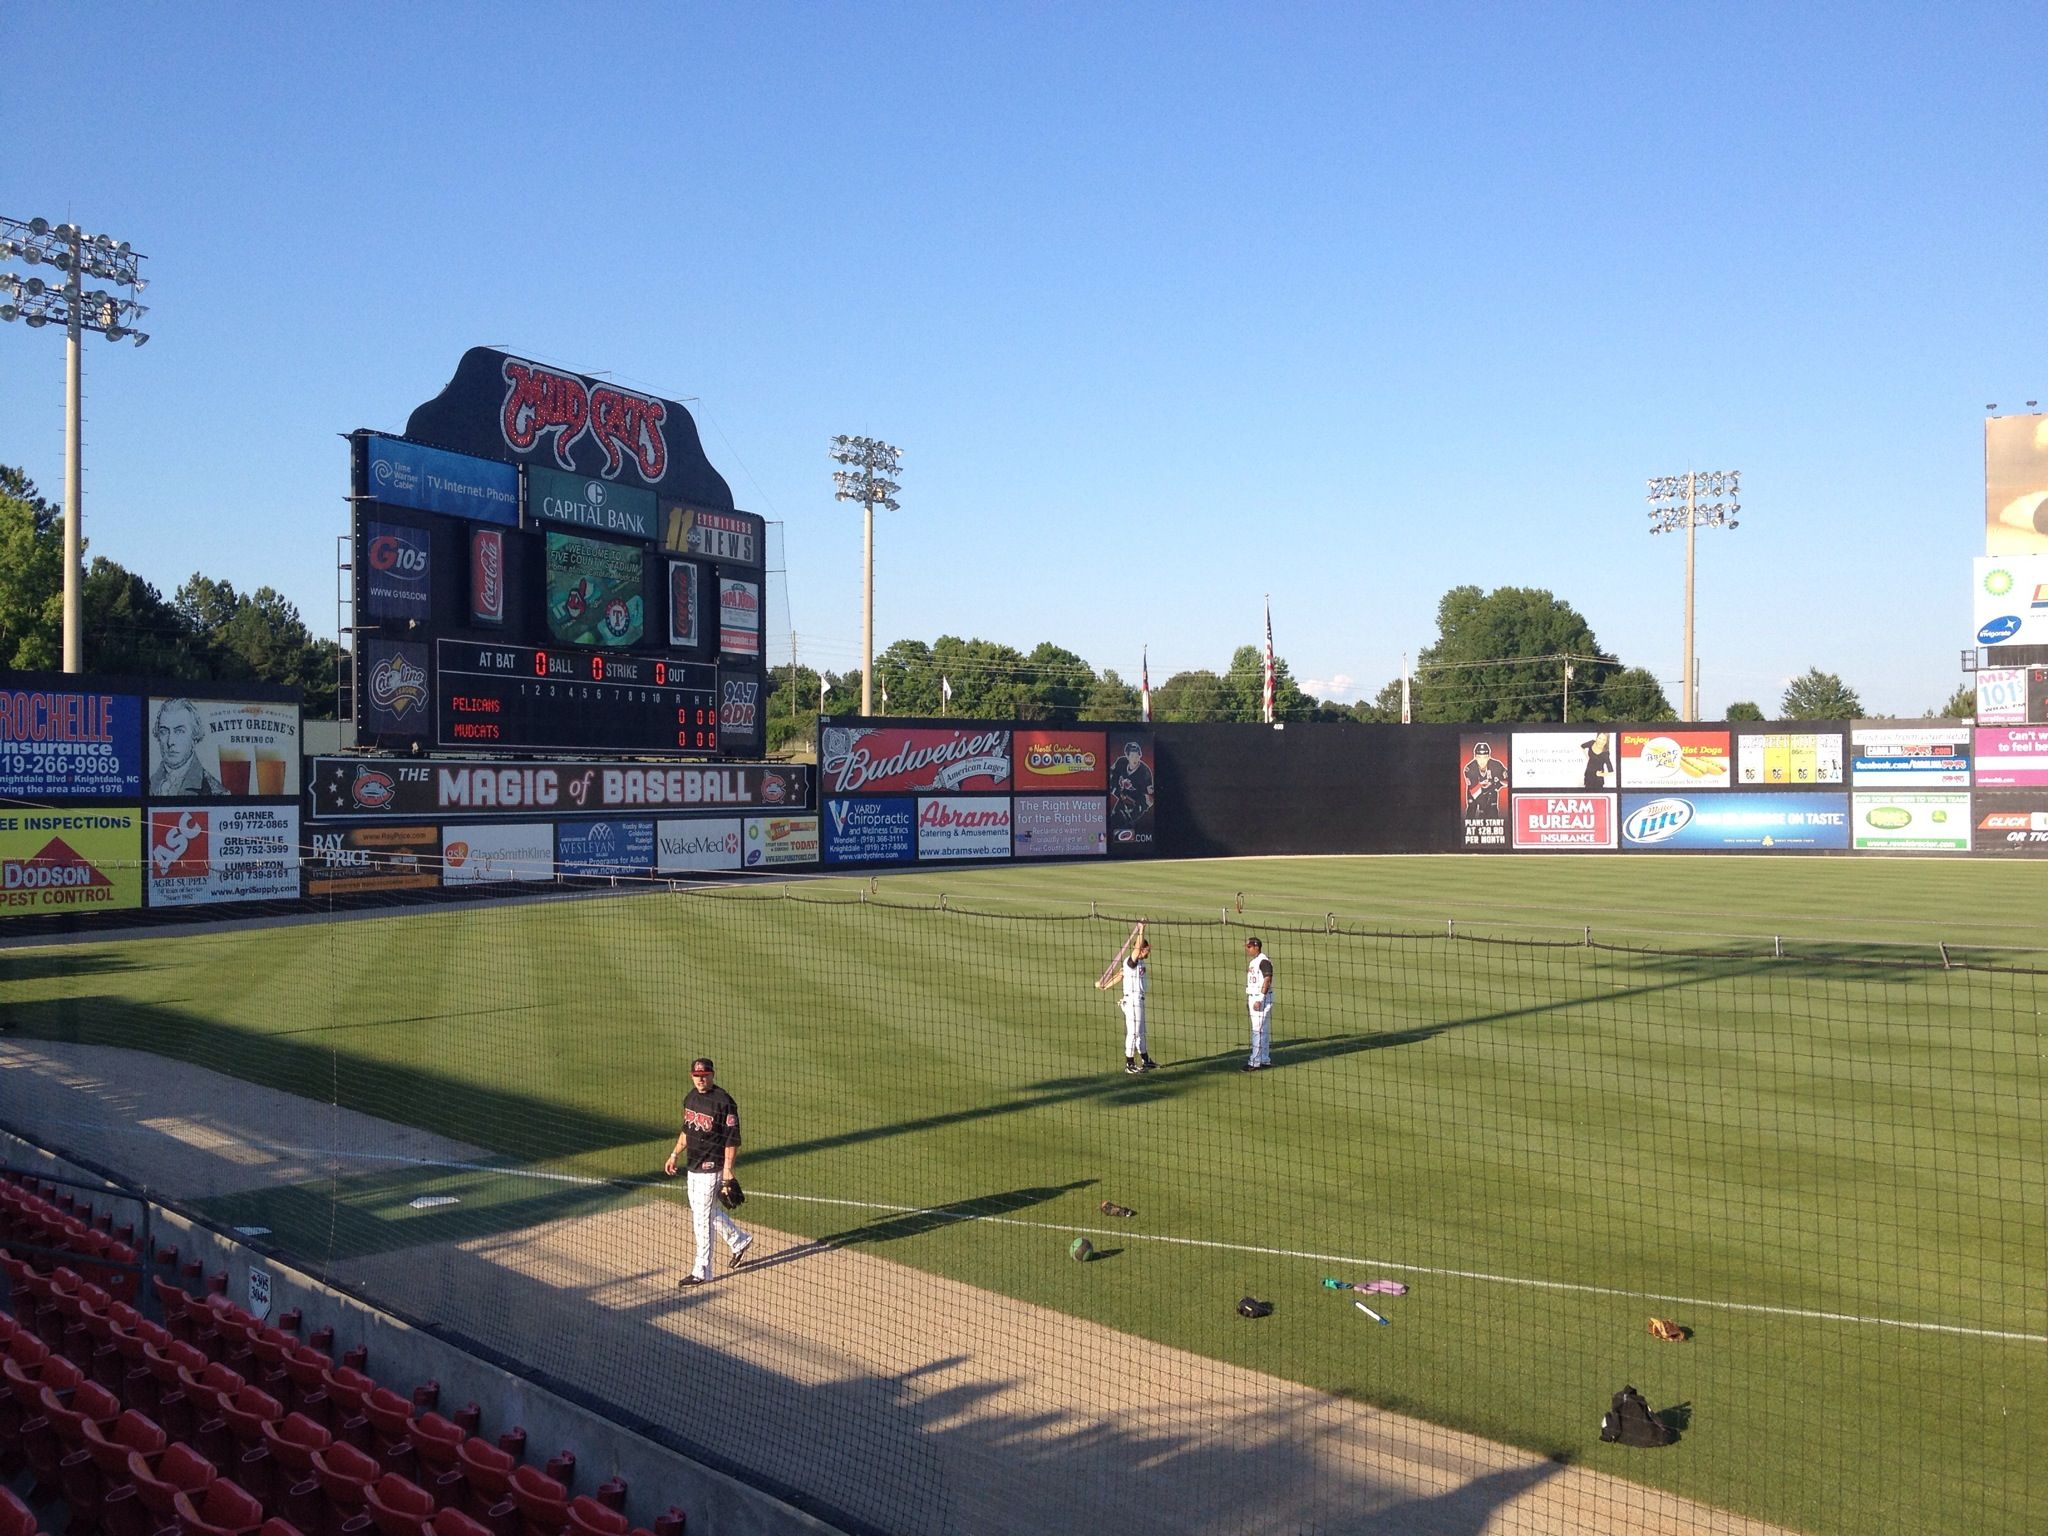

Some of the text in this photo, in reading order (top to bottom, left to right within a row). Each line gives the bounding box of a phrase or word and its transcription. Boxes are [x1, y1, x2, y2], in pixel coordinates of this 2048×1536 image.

[394, 462, 411, 473] Time
[394, 470, 419, 484] Warner
[394, 481, 414, 491] Cable
[543, 497, 645, 534] CAPITAL BANK
[697, 513, 752, 536] EYEWITNESS
[568, 544, 609, 560] WELCOME
[704, 533, 751, 562] NEWS
[551, 550, 569, 562] FIVE
[605, 562, 641, 577] STADIUM
[480, 652, 515, 669] AT BAT
[536, 652, 546, 676] 0
[549, 658, 573, 673] BALL
[593, 657, 603, 680] 0
[606, 663, 638, 679] STRIKE
[656, 663, 665, 685] 0
[669, 669, 686, 682] OUT
[1978, 671, 2018, 684] MIX
[521, 684, 525, 695] 1
[536, 685, 541, 696] 2
[550, 685, 555, 697] 3
[568, 686, 574, 697] 4
[583, 687, 587, 698] 5
[596, 688, 601, 699] 6
[615, 689, 619, 700] 7
[628, 690, 633, 701] 8
[641, 691, 646, 702] 9
[652, 692, 660, 703] 10
[724, 681, 758, 704] 94.7
[0, 692, 112, 743] ROCHELLE
[453, 697, 715, 726] PELICANS 0 0 0
[210, 719, 296, 736] NATTY GREENE'S
[231, 735, 263, 743] BREWING
[454, 723, 715, 748] MUDCATS 0 0 0
[1624, 737, 1650, 746] Enjoy
[2008, 731, 2036, 741] Can't
[1682, 746, 1723, 756] Hot Dogs
[1998, 742, 2032, 752] to feel
[824, 730, 1001, 792] Budweiser
[1032, 754, 1084, 766] POWER
[947, 761, 1005, 782] American Lager
[47, 775, 66, 784] Blvd
[27, 785, 43, 793] the
[72, 785, 96, 793] since
[398, 768, 752, 806] THE MAGIC of BASEBALL
[854, 804, 881, 814] VARDY
[1020, 800, 1101, 813] The Right Water
[1547, 799, 1595, 814] FARM
[234, 811, 274, 820] GARNER
[847, 812, 910, 827] Chiropractic
[918, 801, 1009, 828] Abrams
[1018, 812, 1104, 825] for the Right Use
[25, 816, 131, 830] INSPECTIONS
[220, 820, 288, 831] (919) 772-0865
[1465, 819, 1505, 827] PLANS START
[1529, 814, 1596, 829] BUREAU
[1638, 810, 1684, 838] Lite
[1988, 816, 2030, 827] CLICK
[862, 827, 888, 835] Wellness
[889, 826, 909, 834] Clinics
[919, 829, 951, 838] Catering
[961, 829, 1008, 837] Amusements
[1466, 827, 1476, 836] AT
[2007, 832, 2028, 842] OR
[225, 836, 283, 847] GREENVILLE
[861, 835, 876, 844] (919)
[1465, 836, 1505, 844] PER MONTH
[1541, 833, 1595, 843] INSURANCE
[220, 845, 288, 858] (252) 752-3999
[312, 834, 345, 859] RAY
[560, 841, 615, 854] WESLEYAN
[660, 837, 724, 855] WakeMed
[790, 841, 818, 852] TODAY!
[919, 847, 1009, 856] www.abramsweb.com
[326, 850, 371, 867] PRICE
[447, 849, 465, 864] gsk
[470, 847, 552, 862] GlaxoSmithKline
[589, 857, 619, 867] Programs
[176, 877, 208, 887] SUPPLY
[220, 871, 243, 883] (910)
[43, 887, 114, 905] CONTROL
[211, 884, 297, 898] www.AgriSupply.com
